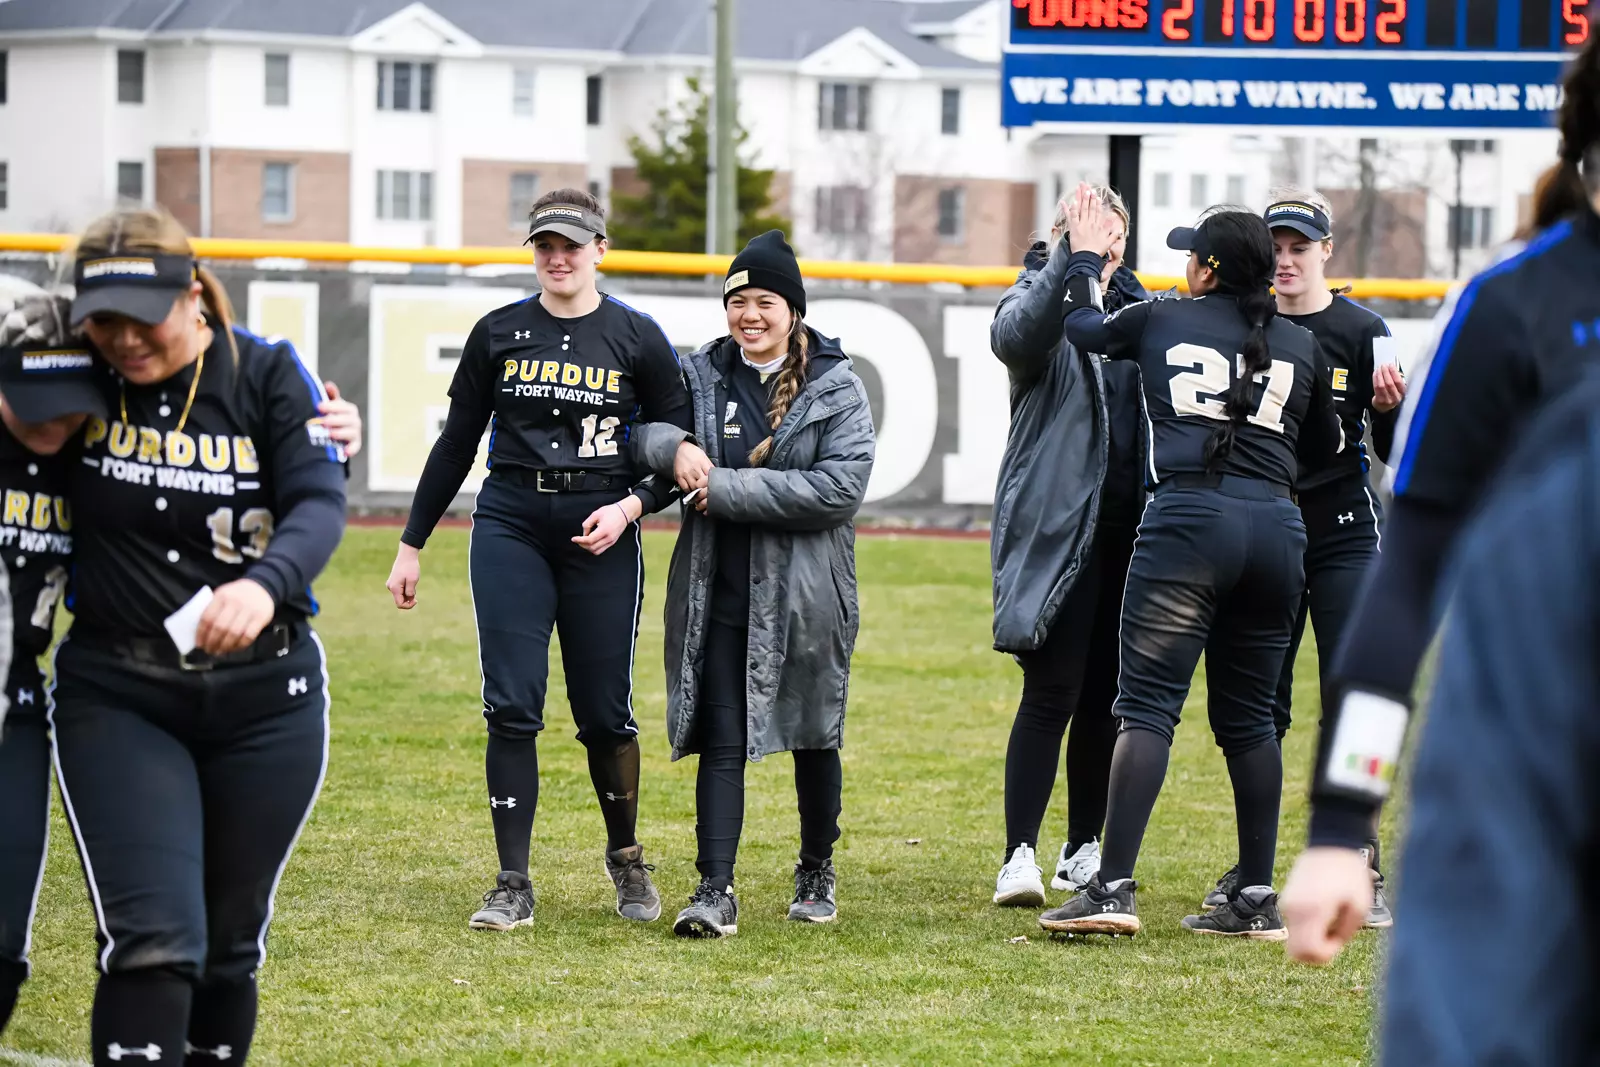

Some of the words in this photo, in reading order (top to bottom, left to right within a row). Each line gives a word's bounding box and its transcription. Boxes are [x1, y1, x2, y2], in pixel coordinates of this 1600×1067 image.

[1009, 77, 1068, 105] WE
[1070, 78, 1143, 106] ARE
[1145, 79, 1241, 107] FORT
[1243, 80, 1378, 110] WAYNE.
[1388, 82, 1446, 110] WE
[1448, 83, 1520, 110] ARE
[503, 359, 623, 393] PURDUE
[515, 384, 552, 398] FORT
[553, 386, 604, 406] WAYNE
[1165, 342, 1294, 434] 27
[84, 417, 260, 473] PURDUE
[578, 413, 621, 458] 12
[101, 455, 155, 486] FORT
[155, 466, 236, 496] WAYNE
[206, 506, 274, 565] 13
